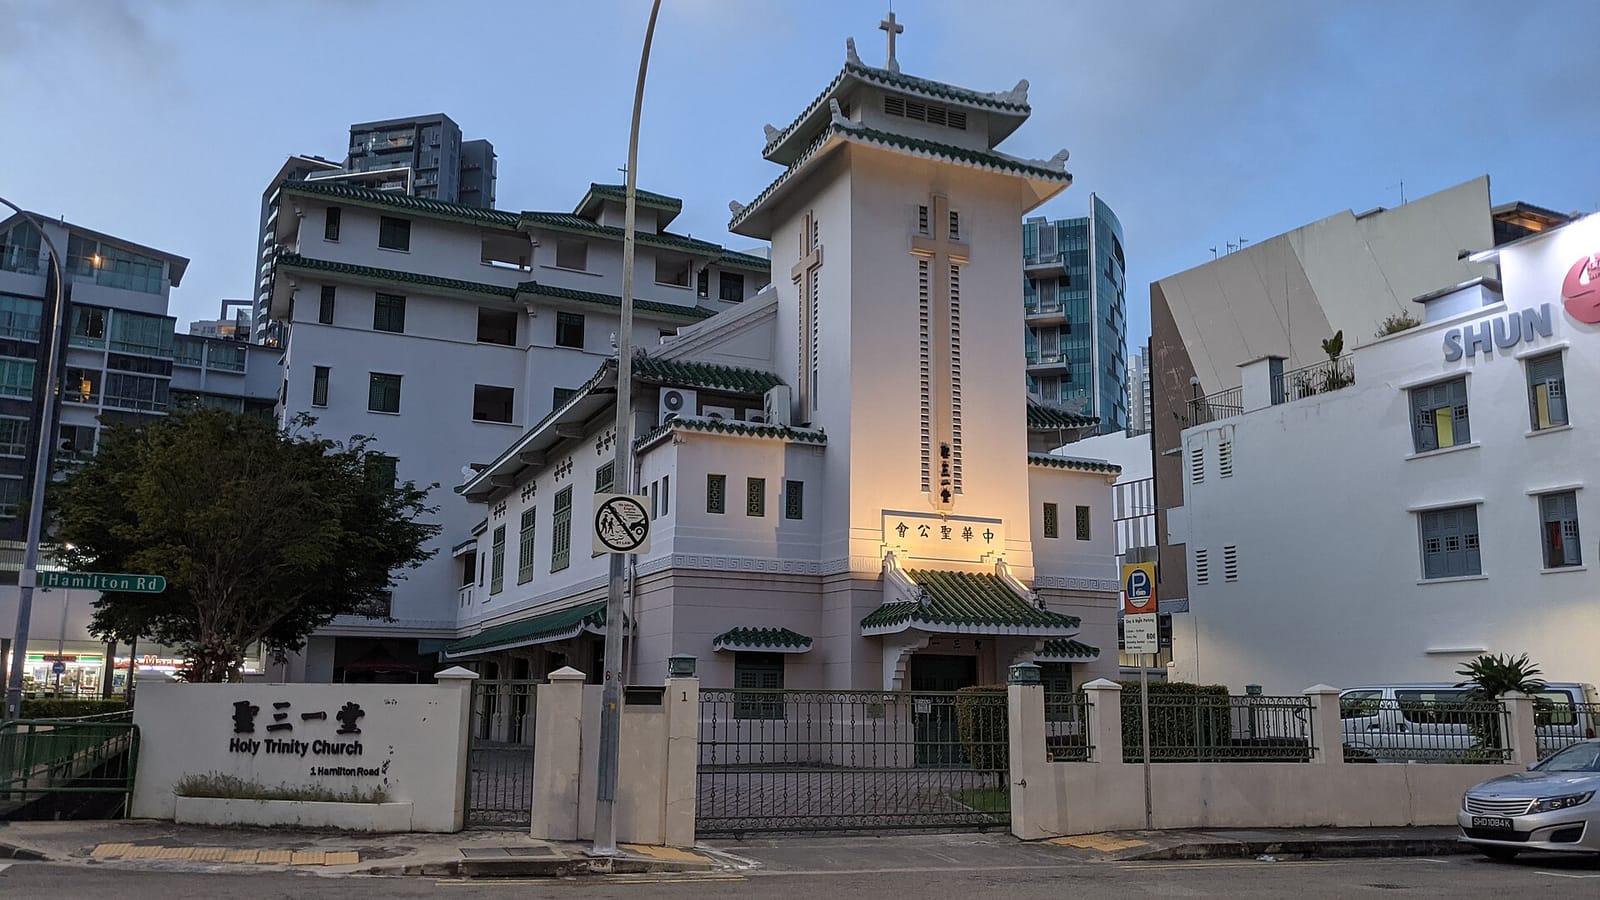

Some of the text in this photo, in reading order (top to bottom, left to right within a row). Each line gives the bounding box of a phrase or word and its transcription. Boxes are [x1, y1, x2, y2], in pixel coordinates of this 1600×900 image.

[1443, 303, 1553, 362] SHUN
[48, 573, 157, 590] Hamilton Rd
[1132, 572, 1146, 597] P
[681, 691, 688, 702] 1
[229, 738, 363, 757] Holy Trinity Church
[310, 766, 380, 776] 1 Hamilton Road
